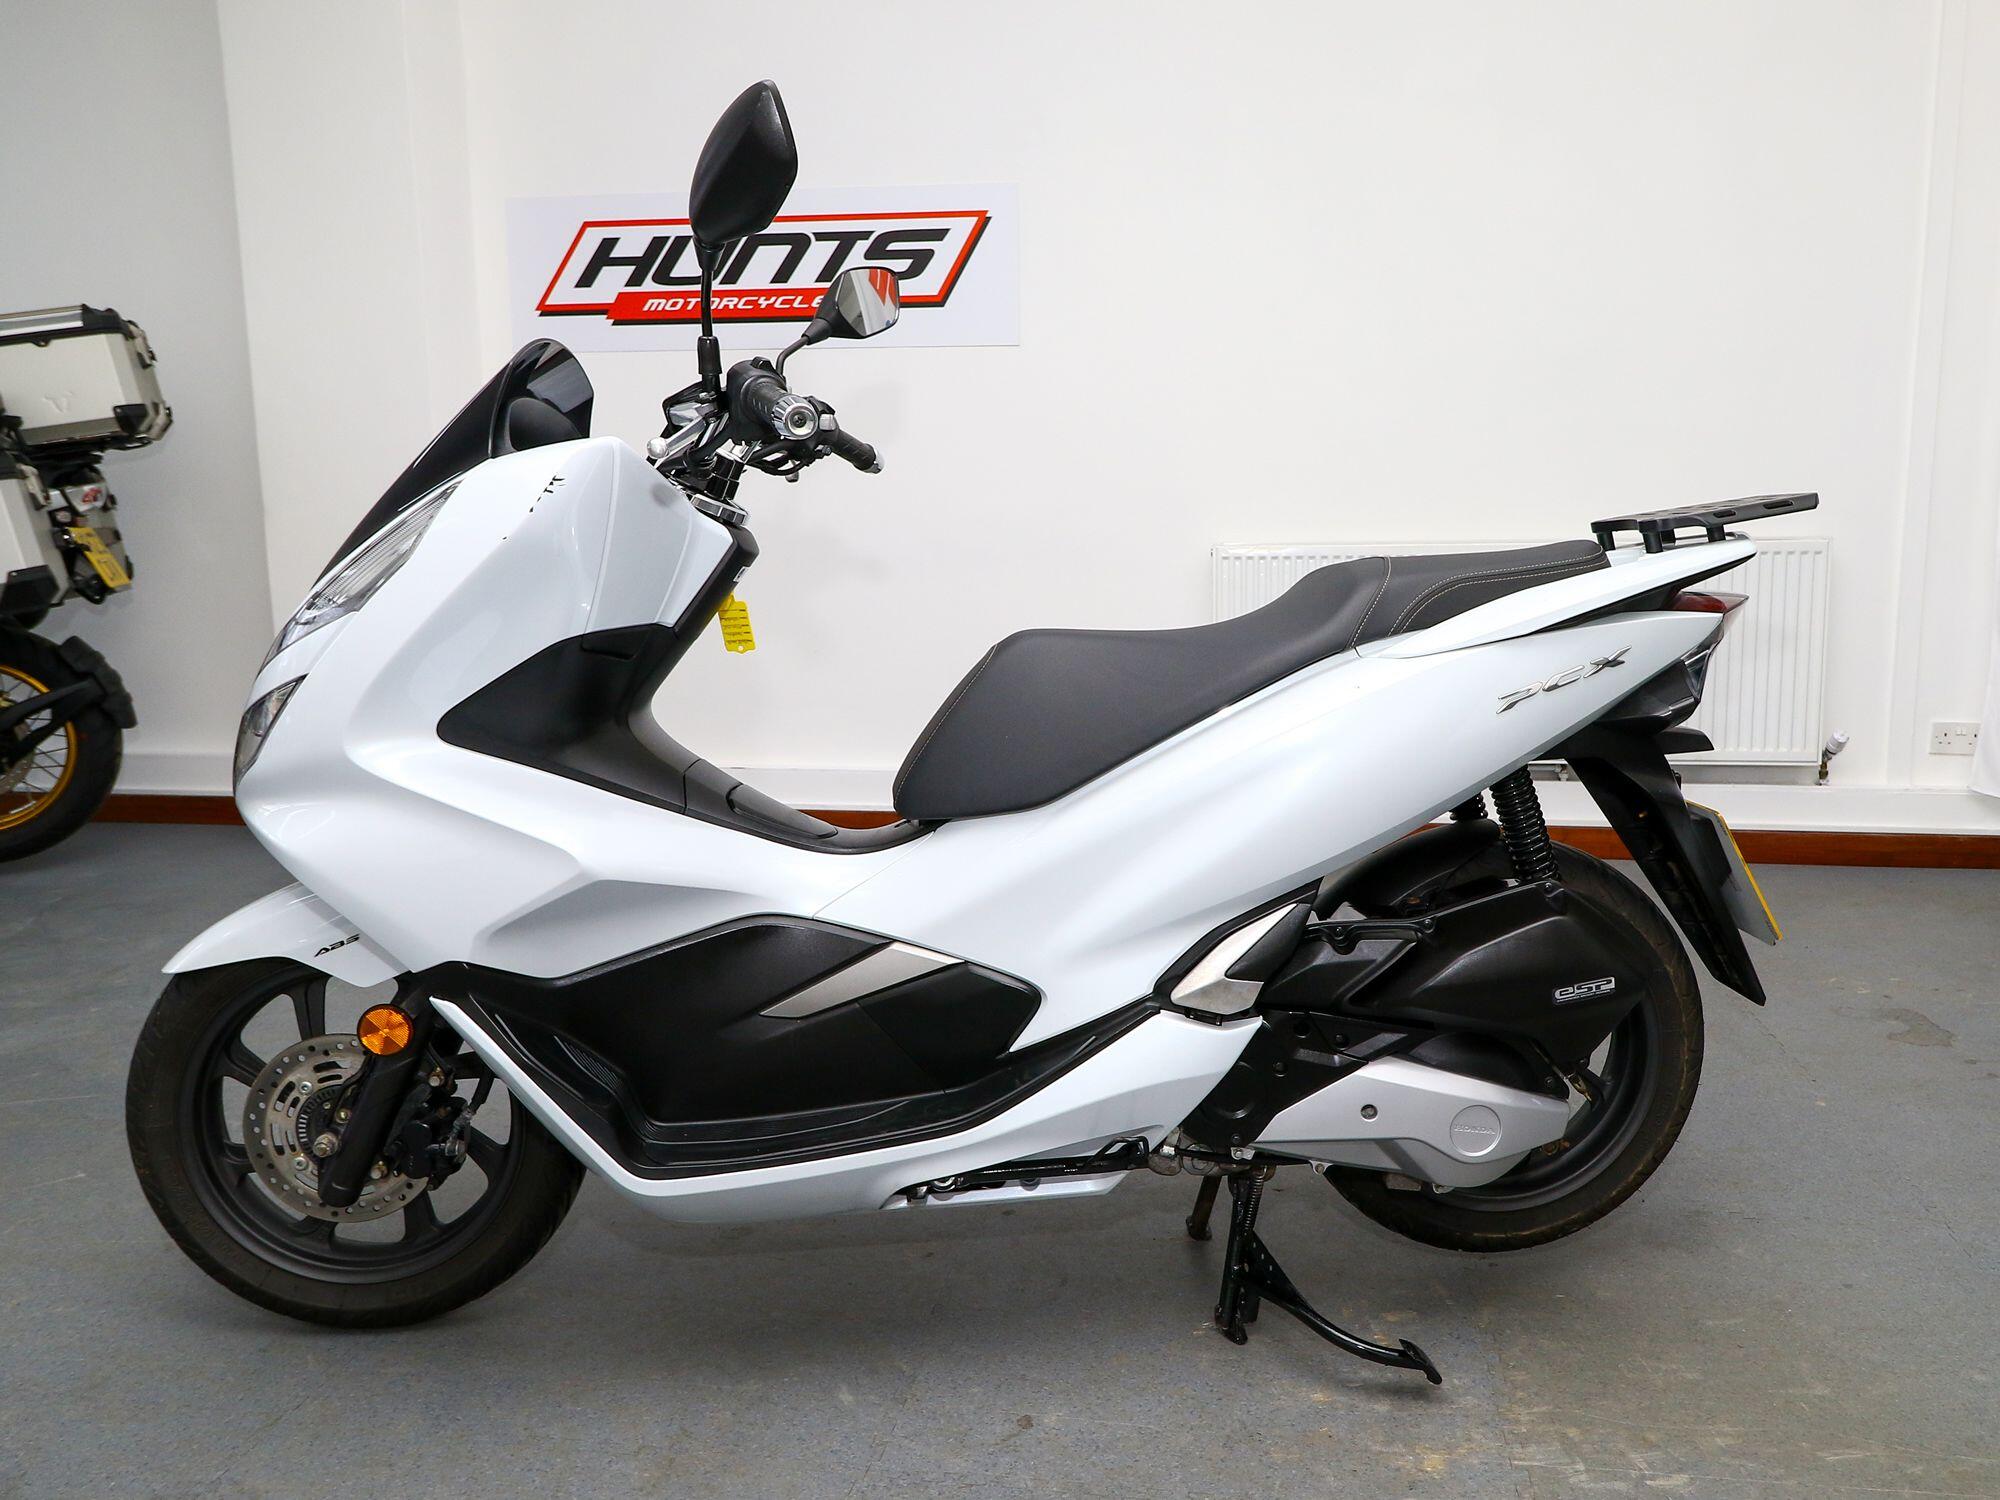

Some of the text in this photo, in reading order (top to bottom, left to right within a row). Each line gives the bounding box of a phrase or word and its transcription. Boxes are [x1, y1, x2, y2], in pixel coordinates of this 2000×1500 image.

[574, 228, 951, 288] HUNTS
[1496, 645, 1632, 714] PCX
[314, 933, 360, 957] ABS
[1453, 1124, 1496, 1135] HONDA
